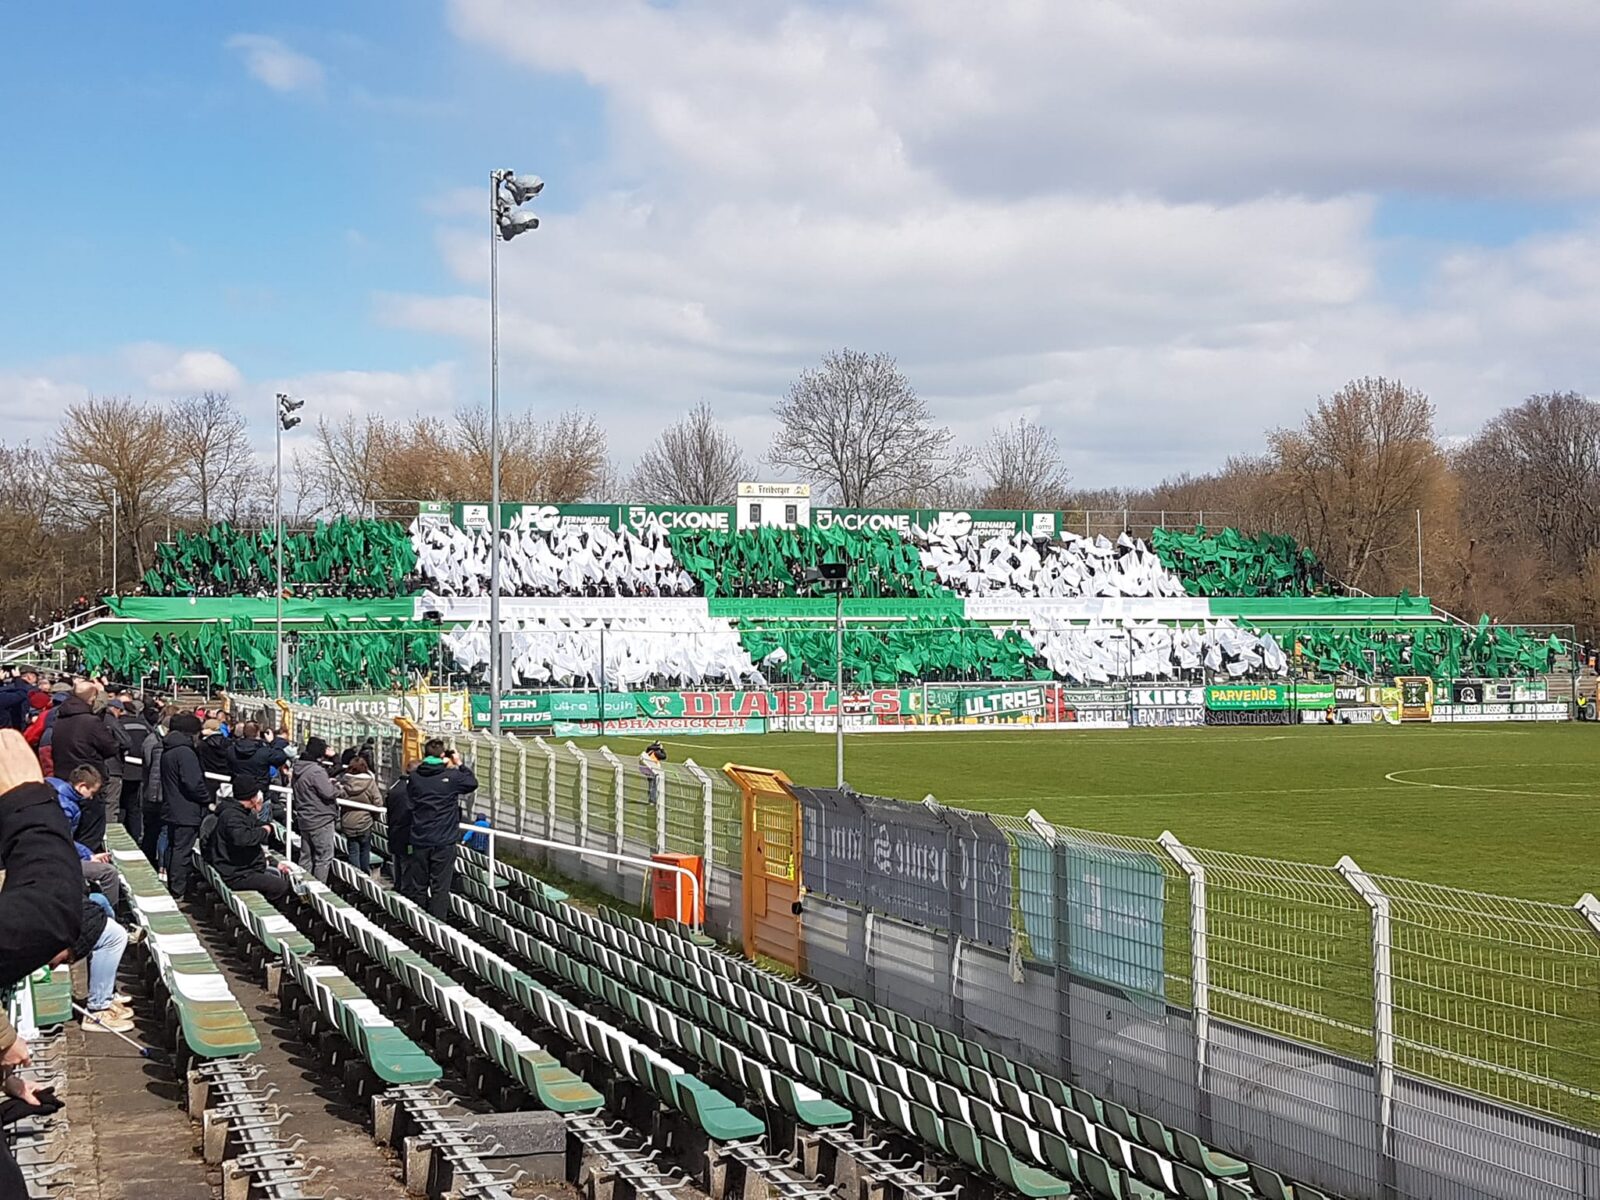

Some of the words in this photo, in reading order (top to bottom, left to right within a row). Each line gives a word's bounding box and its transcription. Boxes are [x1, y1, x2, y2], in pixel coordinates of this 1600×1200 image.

[758, 484, 790, 495] Freiberger
[562, 516, 610, 525] FERNMELDE
[629, 507, 729, 529] JACKONE
[816, 510, 910, 531] JACKONE
[973, 521, 1016, 529] FERNMELDE
[972, 529, 1015, 537] MONTAGEN
[1335, 688, 1356, 700] GWP
[317, 697, 386, 718] Alcatraz
[966, 689, 1040, 715] ULTRAS
[477, 712, 551, 722] BTARDS
